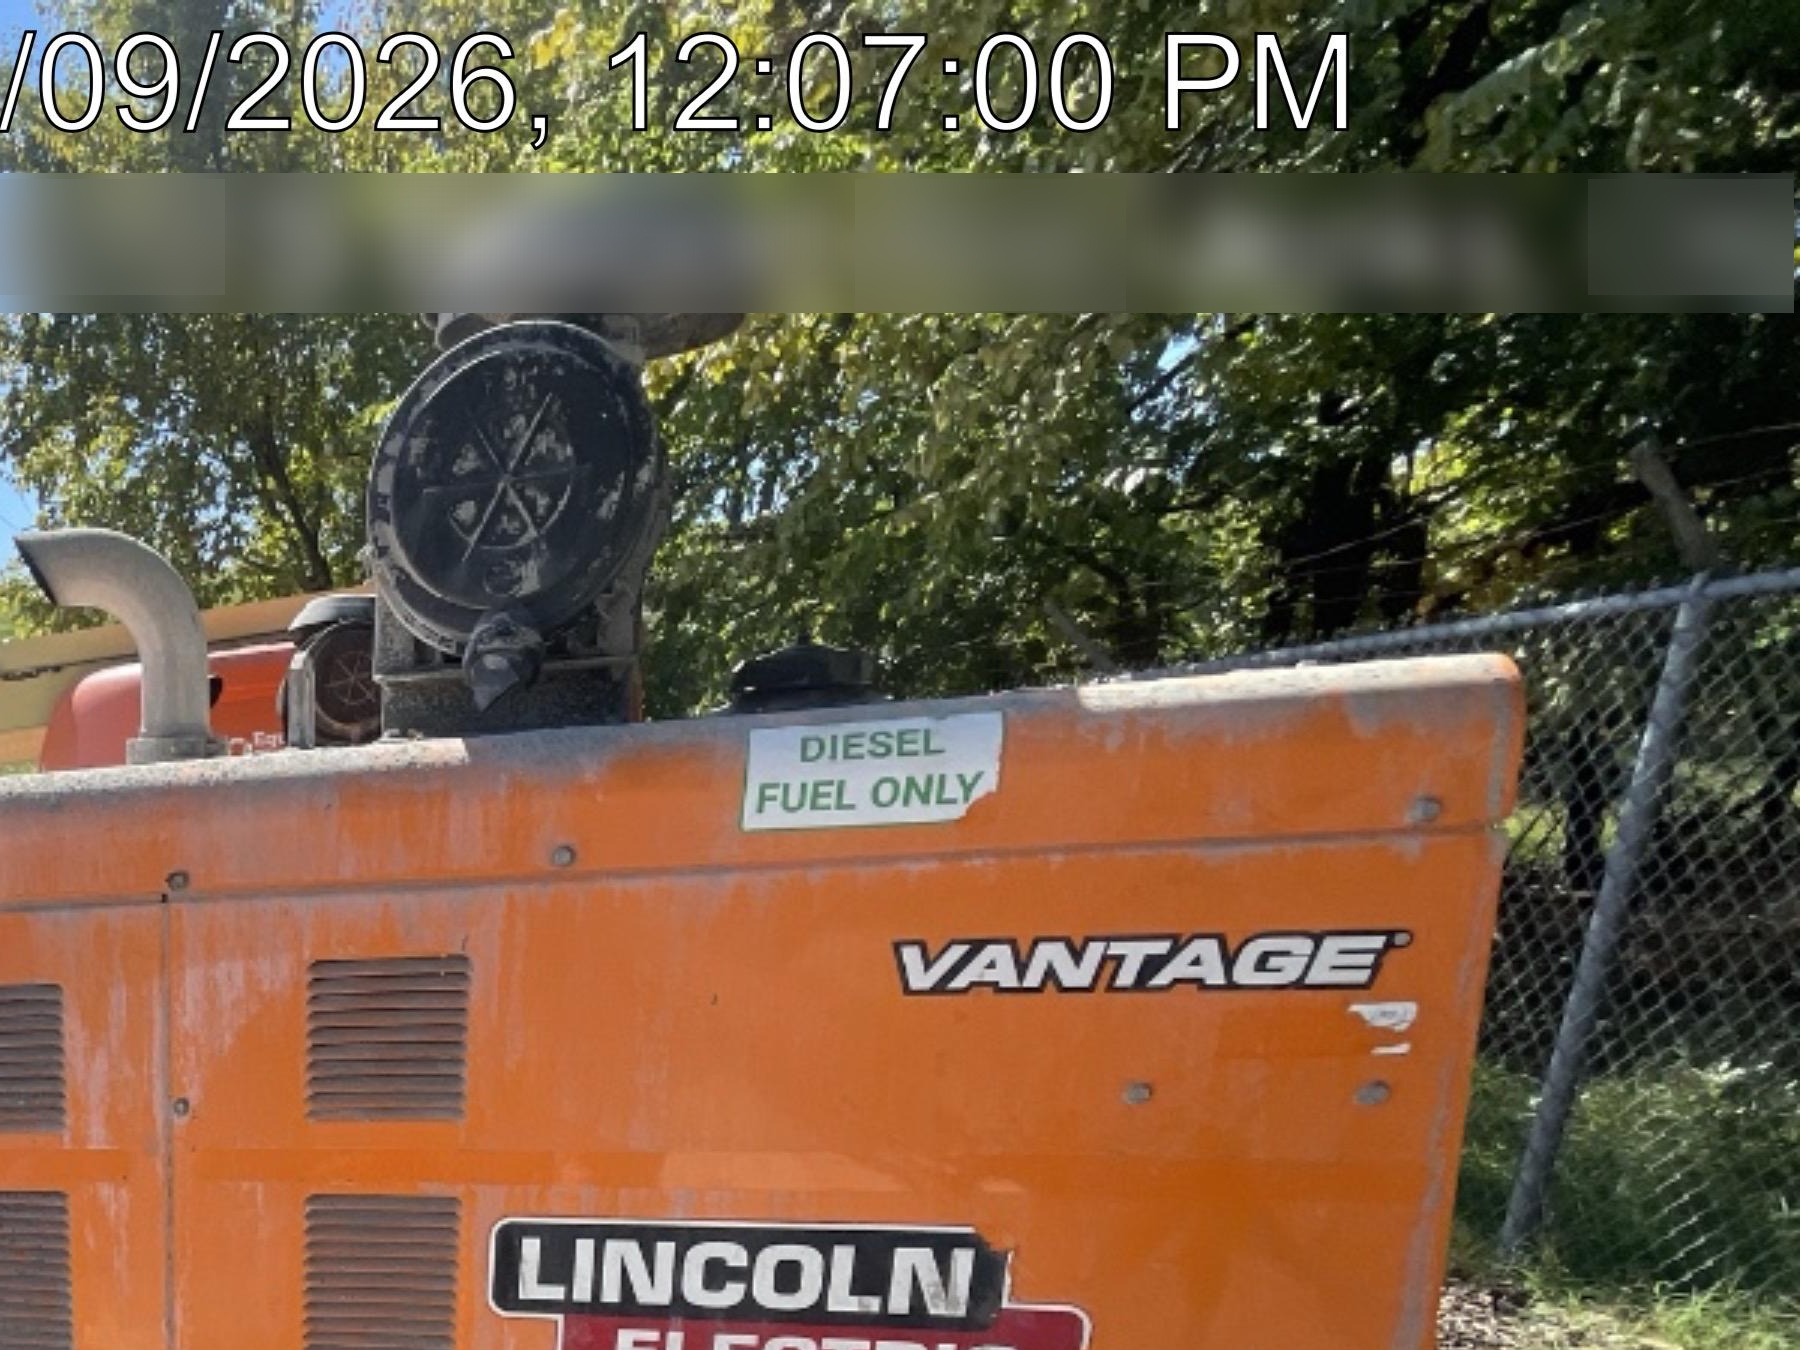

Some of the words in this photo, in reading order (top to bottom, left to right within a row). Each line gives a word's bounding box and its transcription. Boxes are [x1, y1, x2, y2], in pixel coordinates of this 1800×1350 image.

[799, 728, 945, 763] DIESEL
[756, 779, 857, 815] FUEL
[870, 770, 985, 808] ONLY
[900, 932, 1387, 991] VANTAGE
[516, 1234, 975, 1318] LINCOLN
